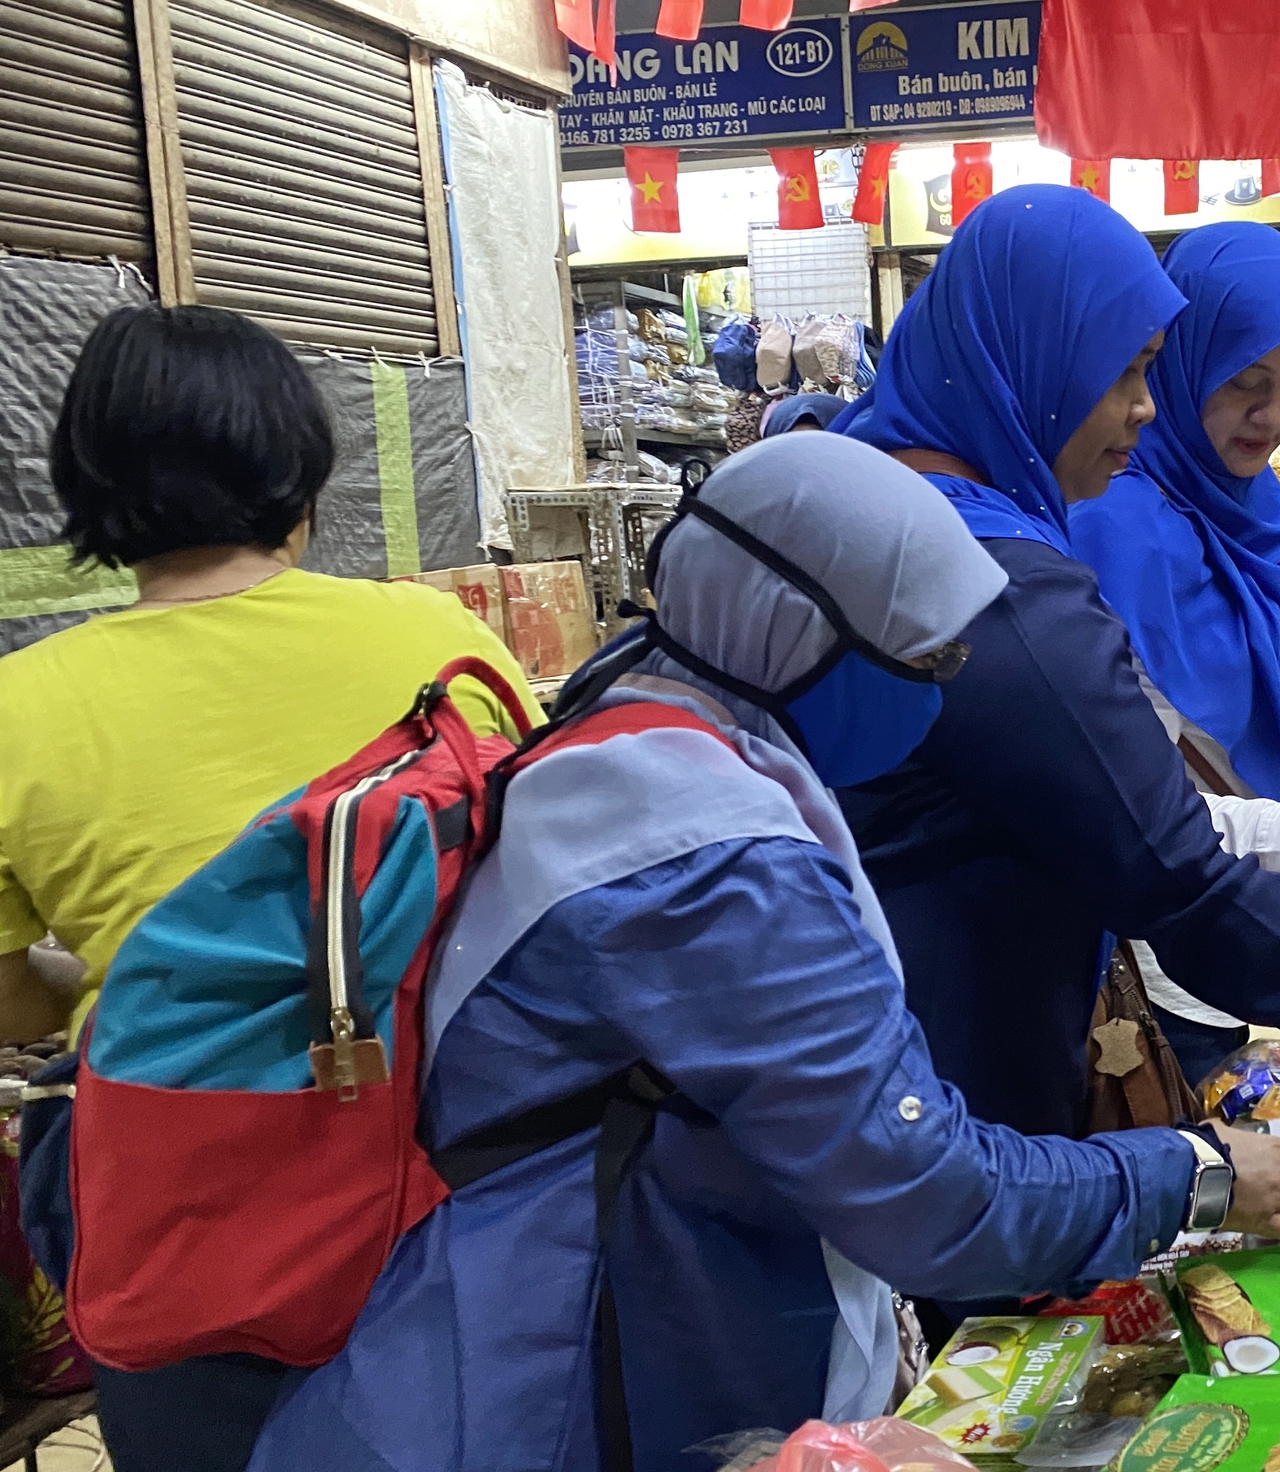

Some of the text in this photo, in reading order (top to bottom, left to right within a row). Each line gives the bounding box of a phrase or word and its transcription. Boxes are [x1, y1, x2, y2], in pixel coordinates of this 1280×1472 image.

[776, 40, 823, 65] 121-B1
[958, 17, 1030, 61] KIM
[675, 41, 739, 75] LAN
[560, 77, 718, 108] CHUYÊN BÁN BUÔN BÁN LẺ
[898, 73, 933, 96] Bán
[993, 66, 1028, 89] bán
[560, 95, 826, 128] TAY KHĂN MẶT KHẨU TRANG MŨ CÁC LOẠI
[592, 129, 615, 144] 781
[619, 126, 651, 142] 3255
[661, 123, 694, 139] 0978
[697, 122, 721, 136] 367
[724, 119, 748, 134] 231
